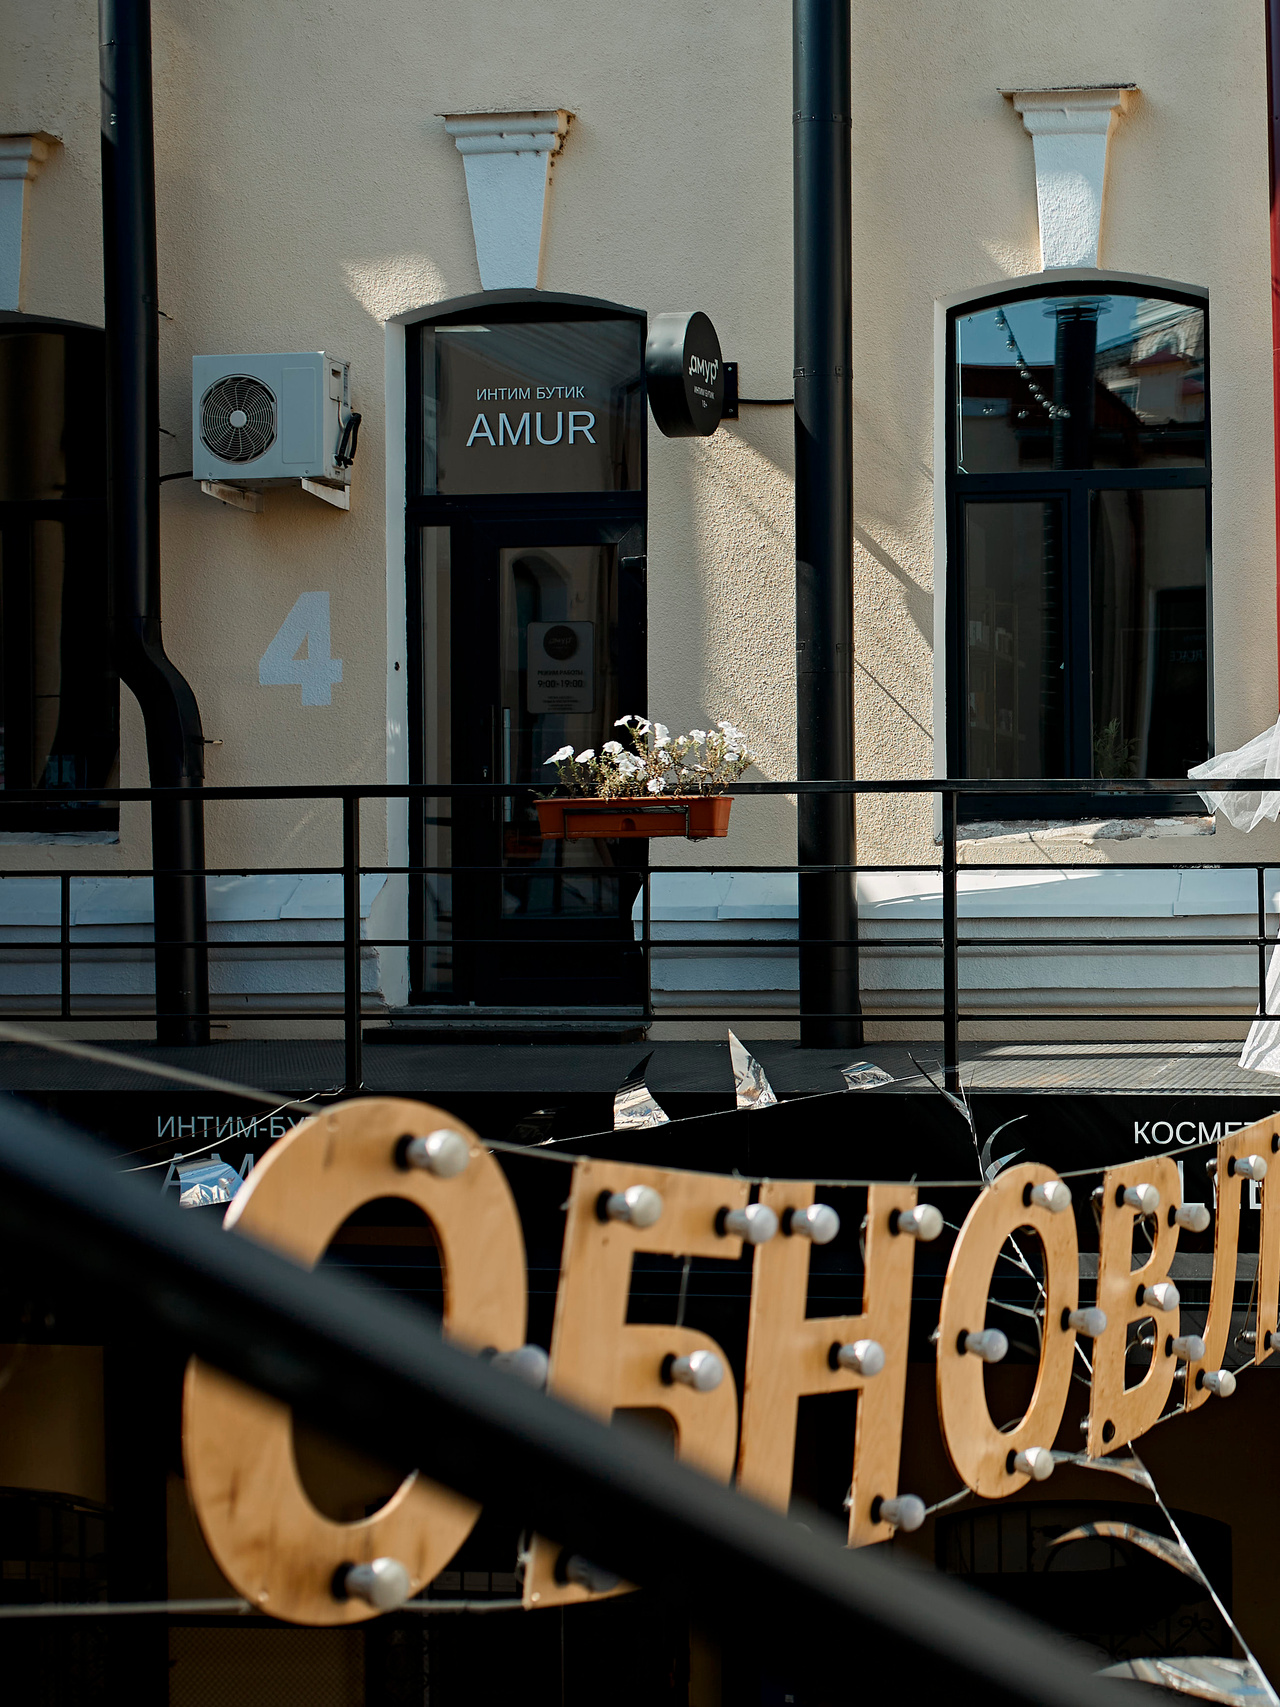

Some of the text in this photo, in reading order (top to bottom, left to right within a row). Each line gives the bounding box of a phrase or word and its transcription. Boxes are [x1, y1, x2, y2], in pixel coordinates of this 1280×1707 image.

[476, 385, 585, 401] ИНТИМ БУТИК
[466, 410, 597, 447] AMUR
[259, 591, 343, 706] 4
